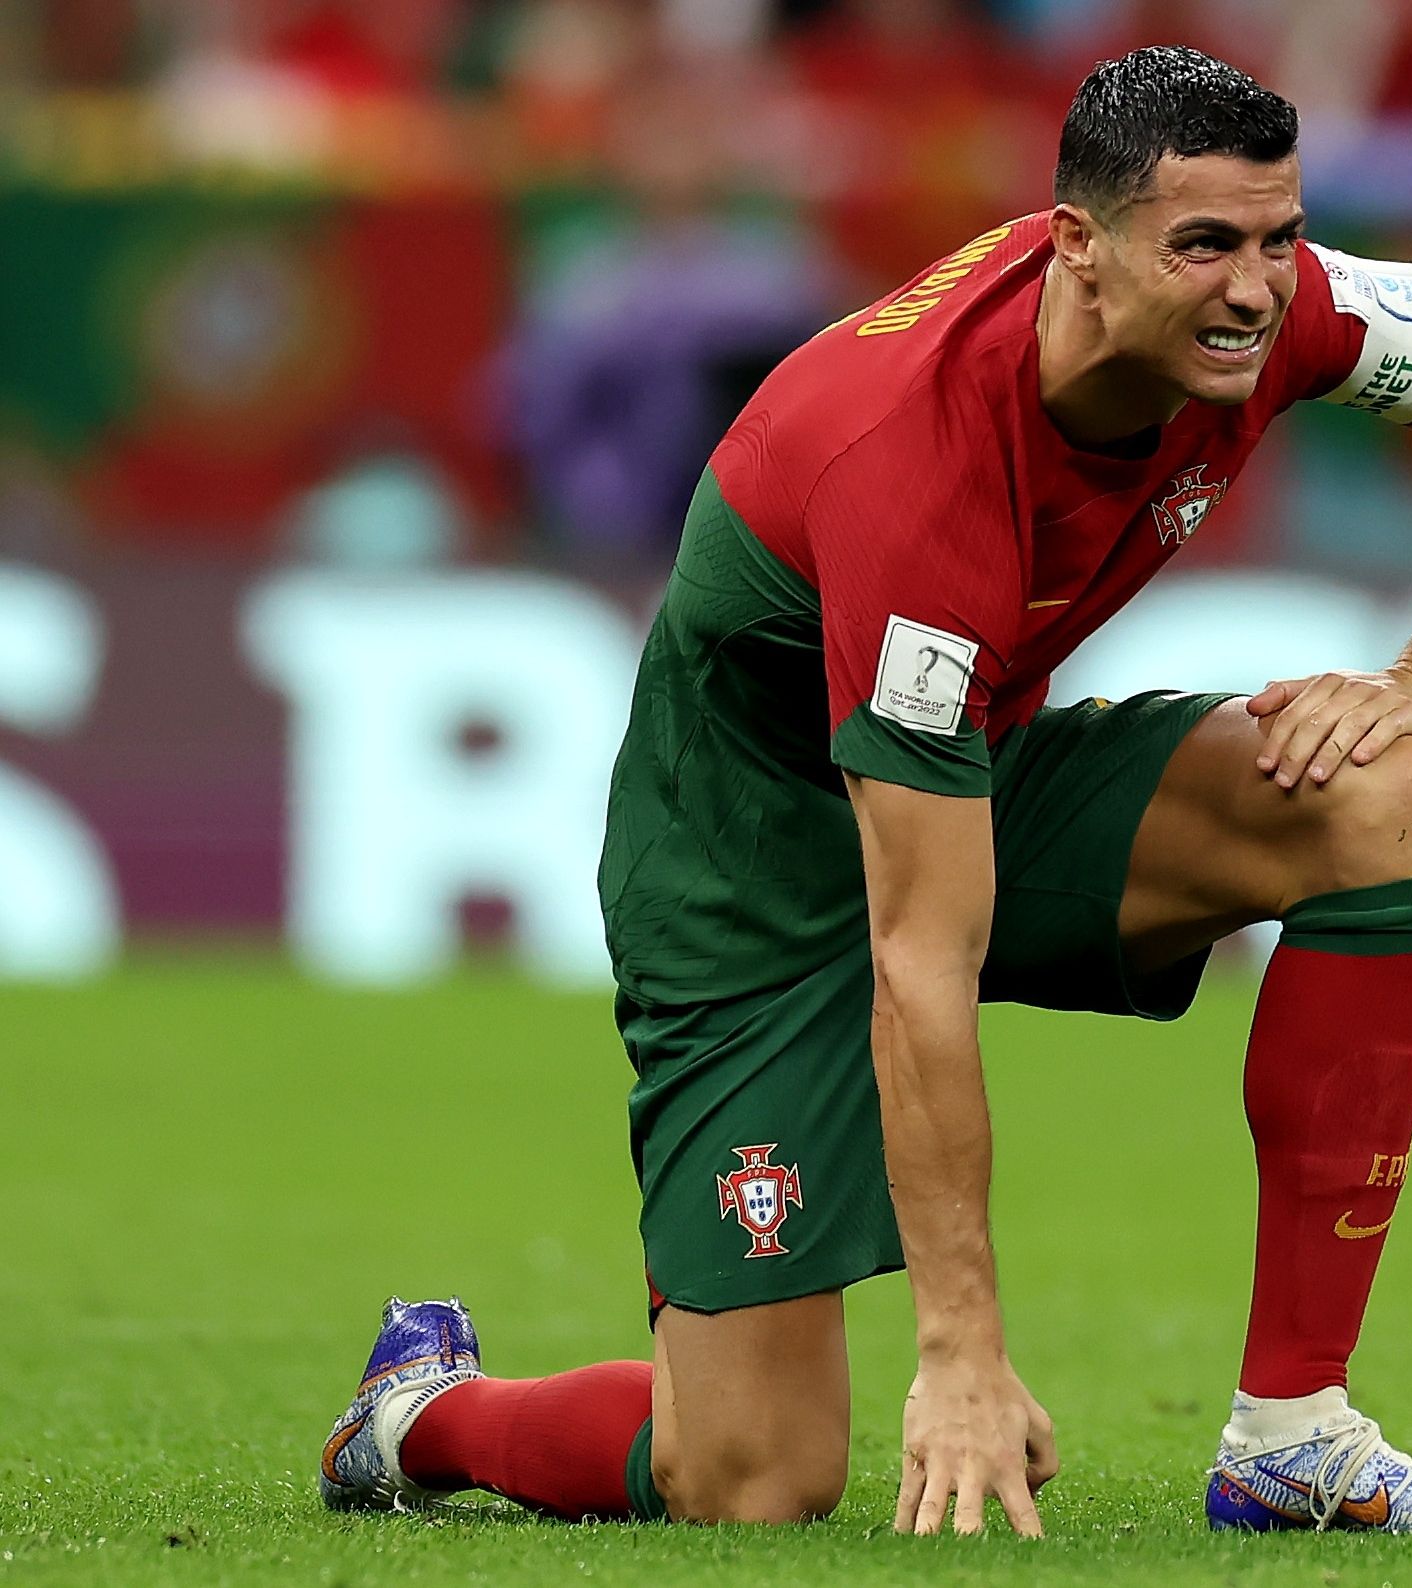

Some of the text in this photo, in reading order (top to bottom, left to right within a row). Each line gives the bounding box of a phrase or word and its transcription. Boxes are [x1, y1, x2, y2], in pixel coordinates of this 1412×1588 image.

[1355, 352, 1399, 399] THE
[889, 688, 947, 709] FIFA WORLD CUP
